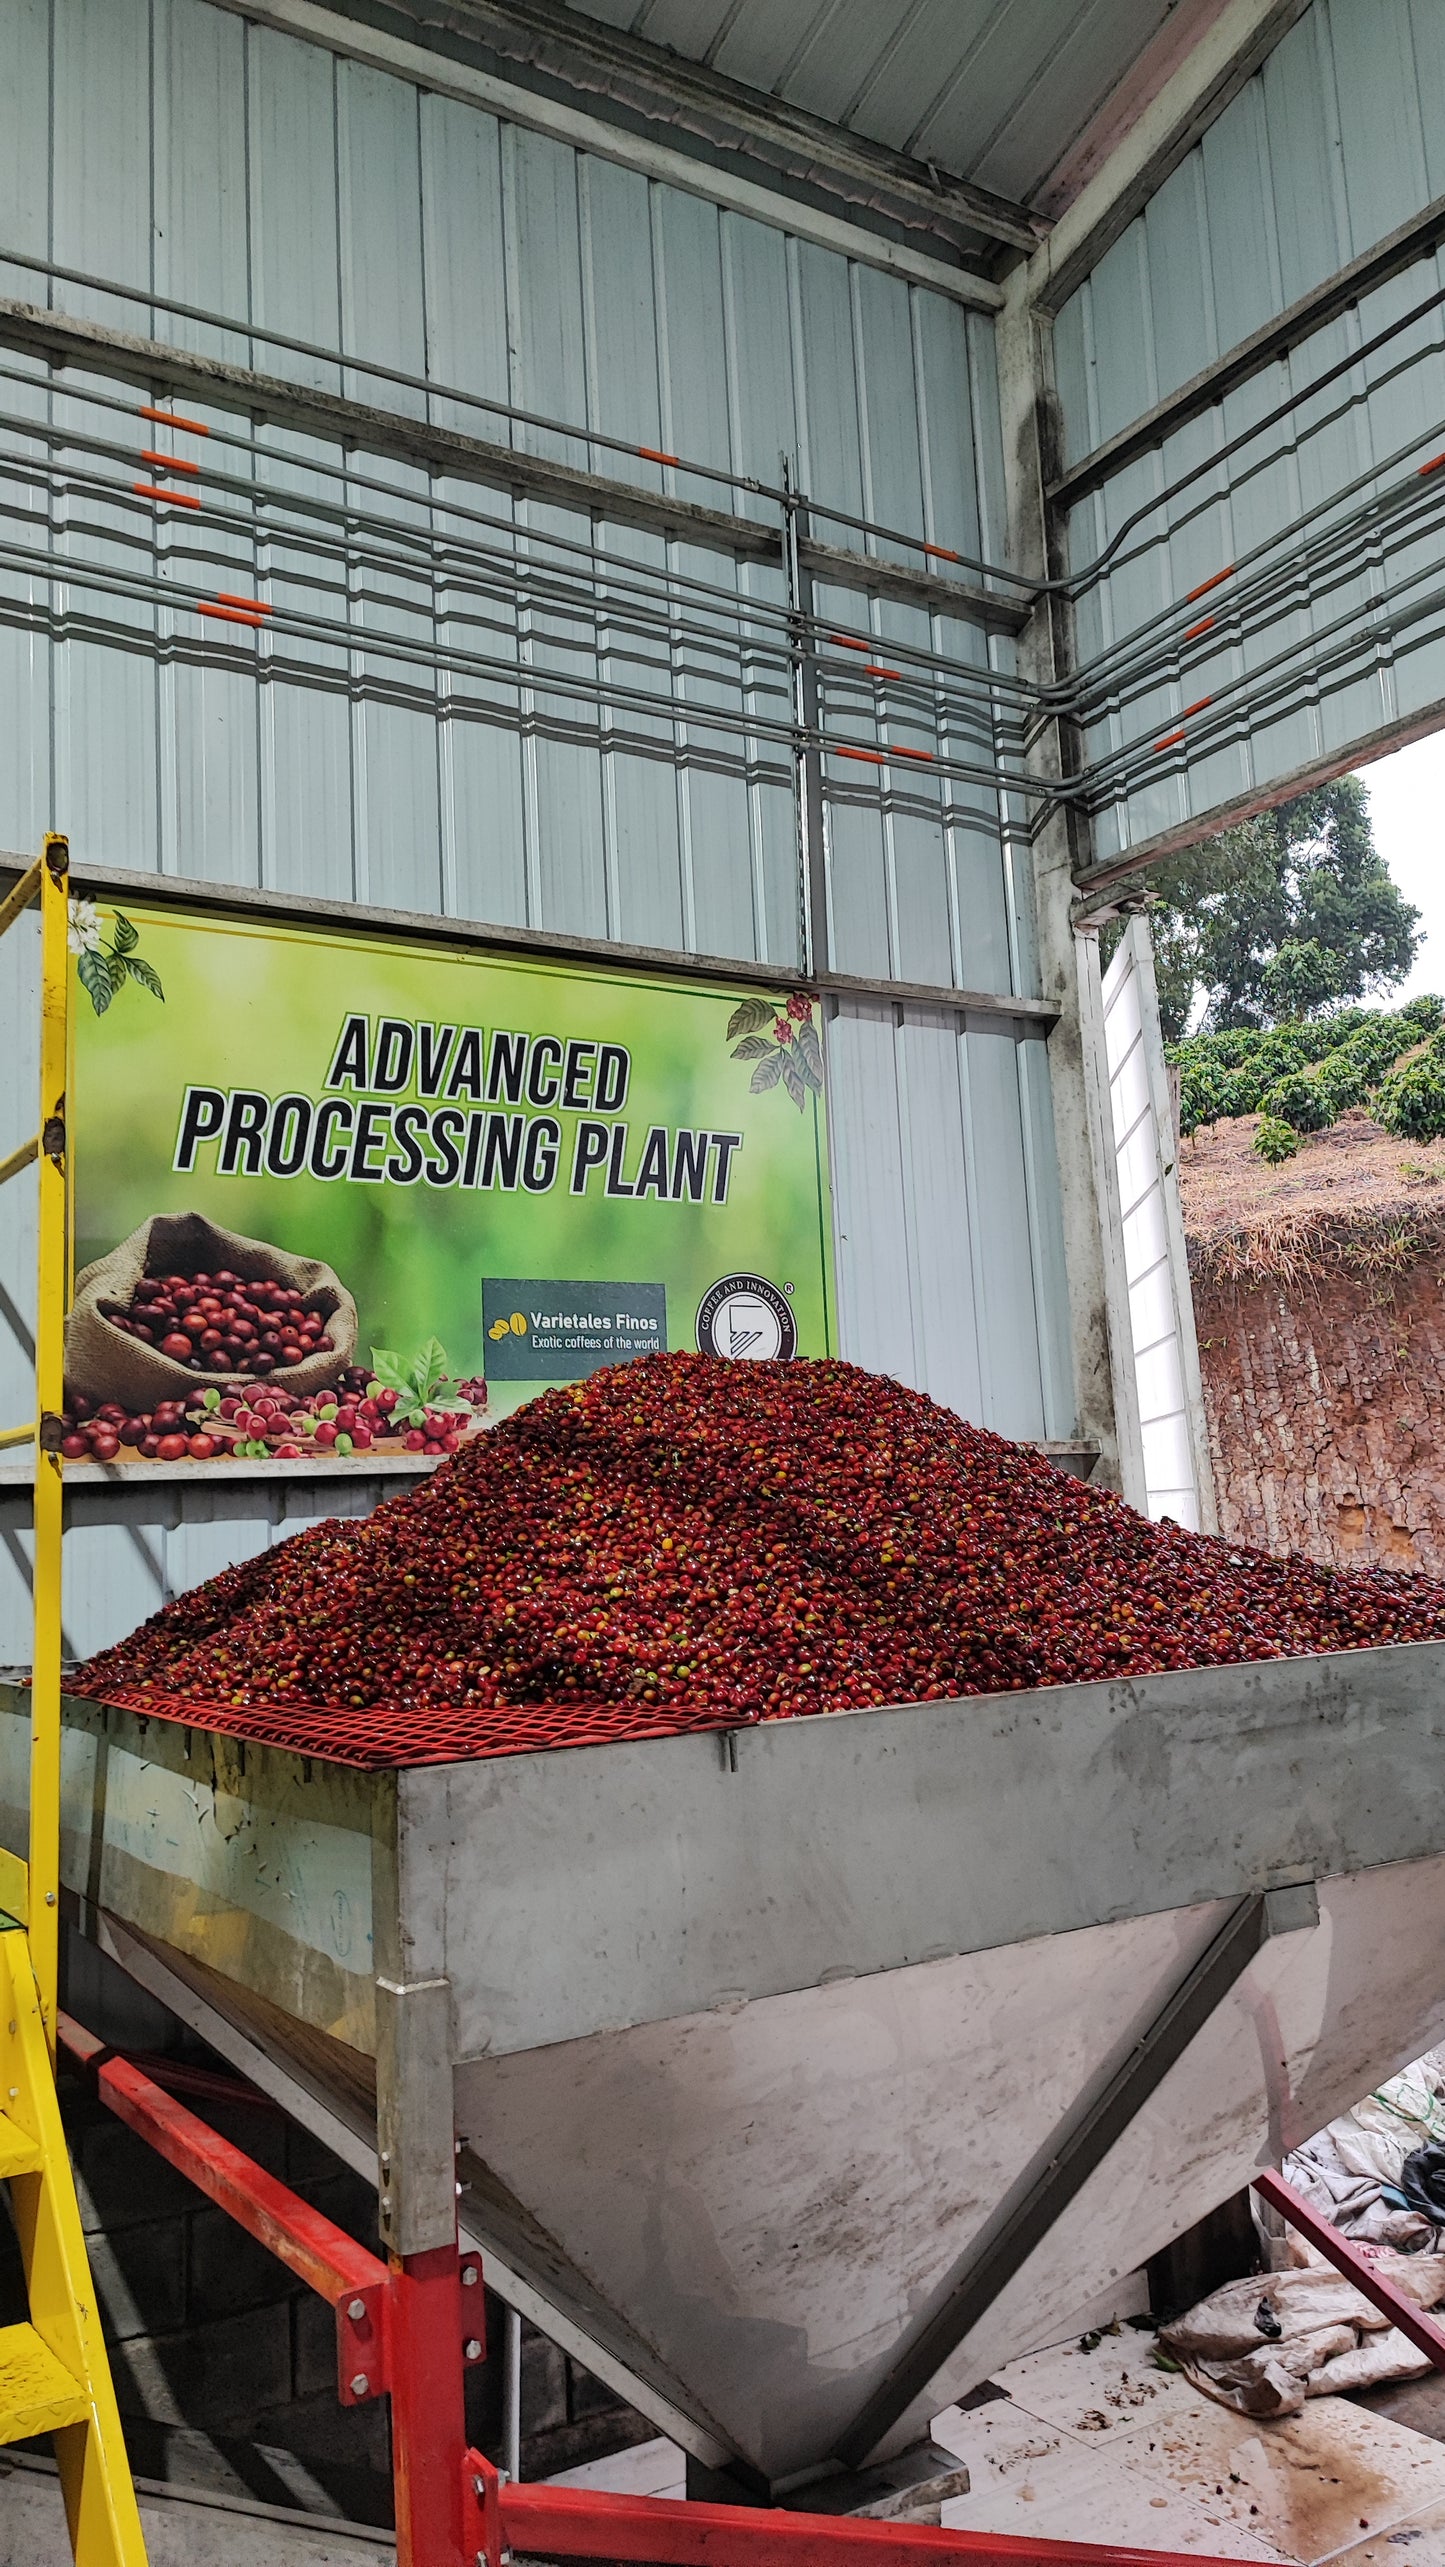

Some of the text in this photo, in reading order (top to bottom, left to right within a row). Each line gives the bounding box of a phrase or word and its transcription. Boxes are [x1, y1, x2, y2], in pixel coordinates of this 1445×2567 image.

[325, 1013, 631, 1113] ADVANCED
[172, 1085, 743, 1205] PROCESSING PLANT
[529, 1312, 658, 1330] Varietales Finos
[701, 1280, 791, 1332] COFFEE AND INNOVATION
[532, 1335, 660, 1350] Exotic coffees of the world
